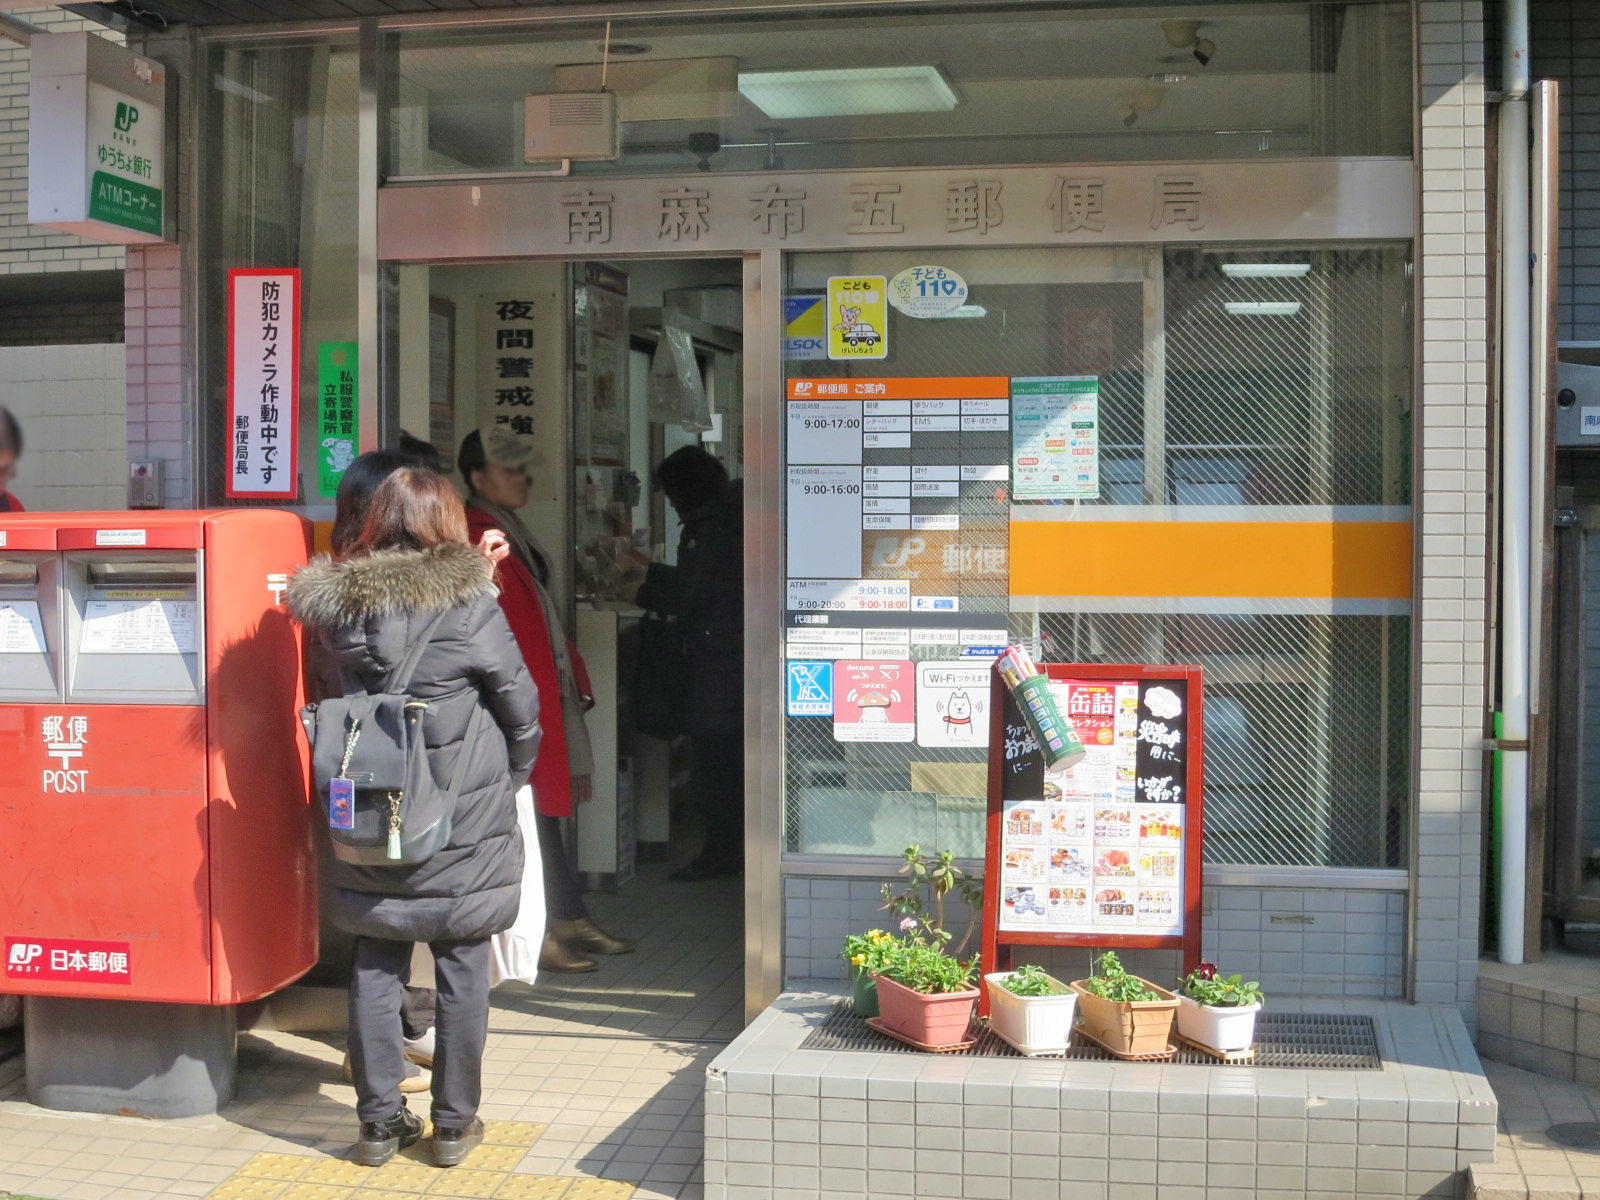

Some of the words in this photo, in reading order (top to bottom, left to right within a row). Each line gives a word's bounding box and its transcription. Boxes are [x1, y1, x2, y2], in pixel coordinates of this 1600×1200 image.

[114, 101, 139, 132] JP
[112, 131, 137, 146] BANK
[98, 144, 152, 180] ゆうちょ銀行
[98, 182, 157, 210] ATMコーナー
[561, 174, 1206, 245] 南麻布五郵便局
[911, 267, 947, 280] 子ども
[843, 281, 871, 290] こども
[835, 291, 879, 304] 110番
[260, 281, 280, 484] 防犯カメラ作動中です
[817, 383, 848, 395] 郵便局
[855, 383, 887, 395] ご案内
[323, 383, 338, 435] 立寄場所
[339, 370, 353, 434] 私服警察官
[804, 418, 860, 429] 9:00-17:00
[914, 417, 932, 426] EMS
[235, 415, 249, 475] 郵便局長
[804, 484, 860, 495] 9:00-16:00
[941, 543, 1008, 574] 郵便
[859, 586, 908, 595] 9:00-18:00
[798, 600, 846, 609] 9:00-20:00
[859, 600, 908, 609] 9:00-18:00
[794, 614, 829, 624] 代理業務
[929, 673, 956, 684] Wi-Fi
[956, 674, 990, 682] つかえます
[1069, 691, 1115, 715] 缶詰
[41, 715, 88, 744] 郵便
[43, 770, 89, 794] POST
[1137, 776, 1173, 789] いかが
[7, 964, 41, 972] POST
[50, 949, 129, 974] 日本郵便
